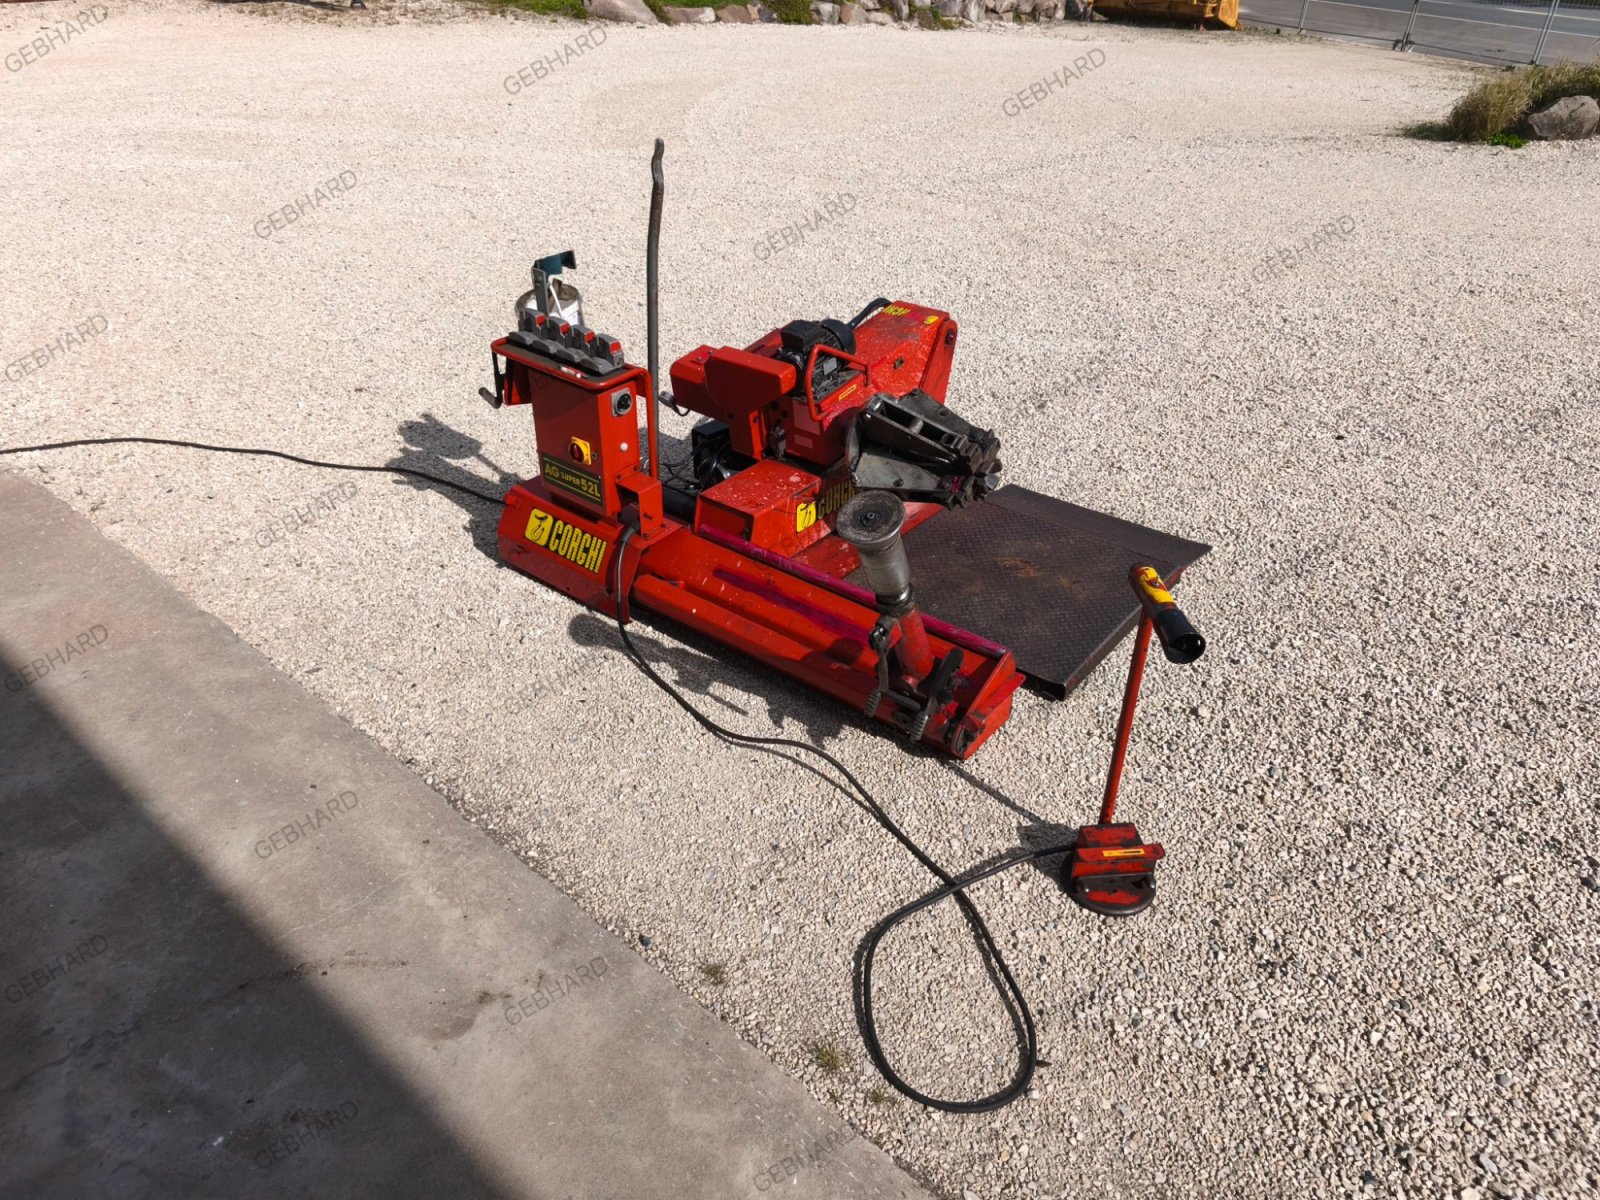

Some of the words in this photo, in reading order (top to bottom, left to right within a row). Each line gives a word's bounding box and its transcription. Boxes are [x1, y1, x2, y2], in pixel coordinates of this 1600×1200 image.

[544, 463, 560, 478] AG
[580, 478, 601, 498] 52L
[548, 519, 607, 574] CORGHI
